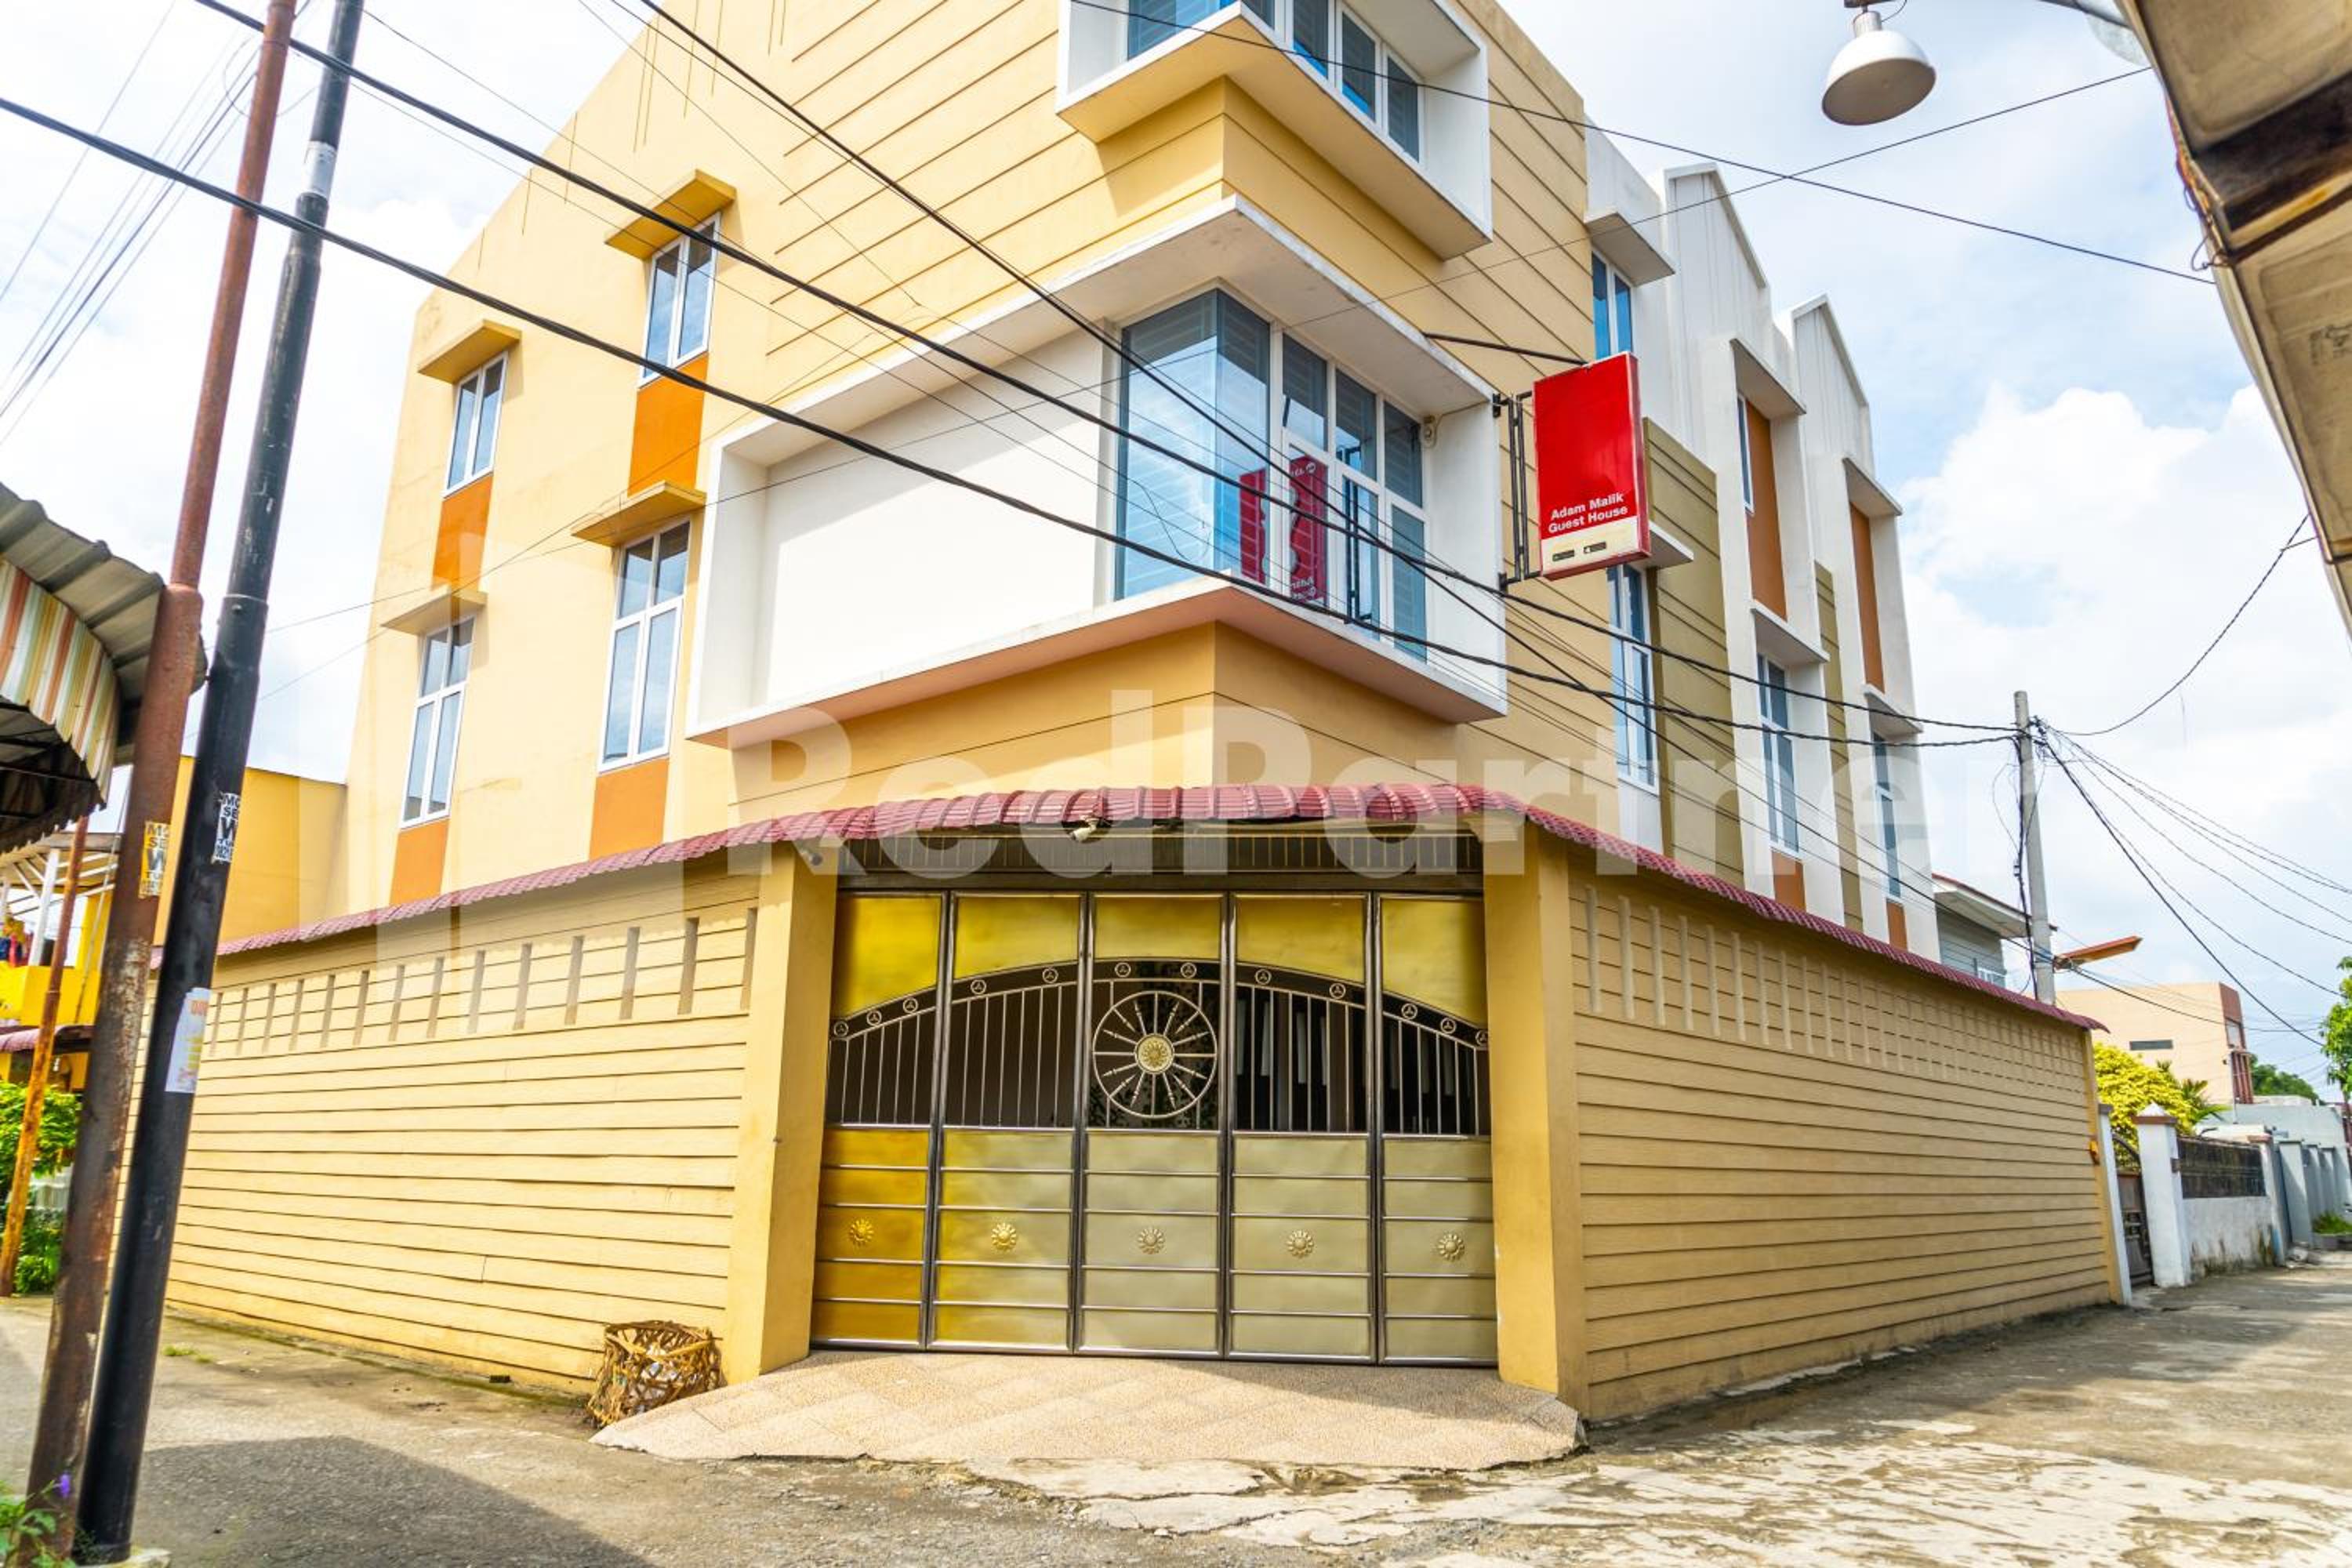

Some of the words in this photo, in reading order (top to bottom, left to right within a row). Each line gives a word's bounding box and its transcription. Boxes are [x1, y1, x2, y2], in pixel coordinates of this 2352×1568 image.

[1548, 516, 1584, 533] Guest
[1588, 506, 1628, 523] House
[1550, 504, 1586, 521] Adam
[1589, 492, 1624, 510] Malik
